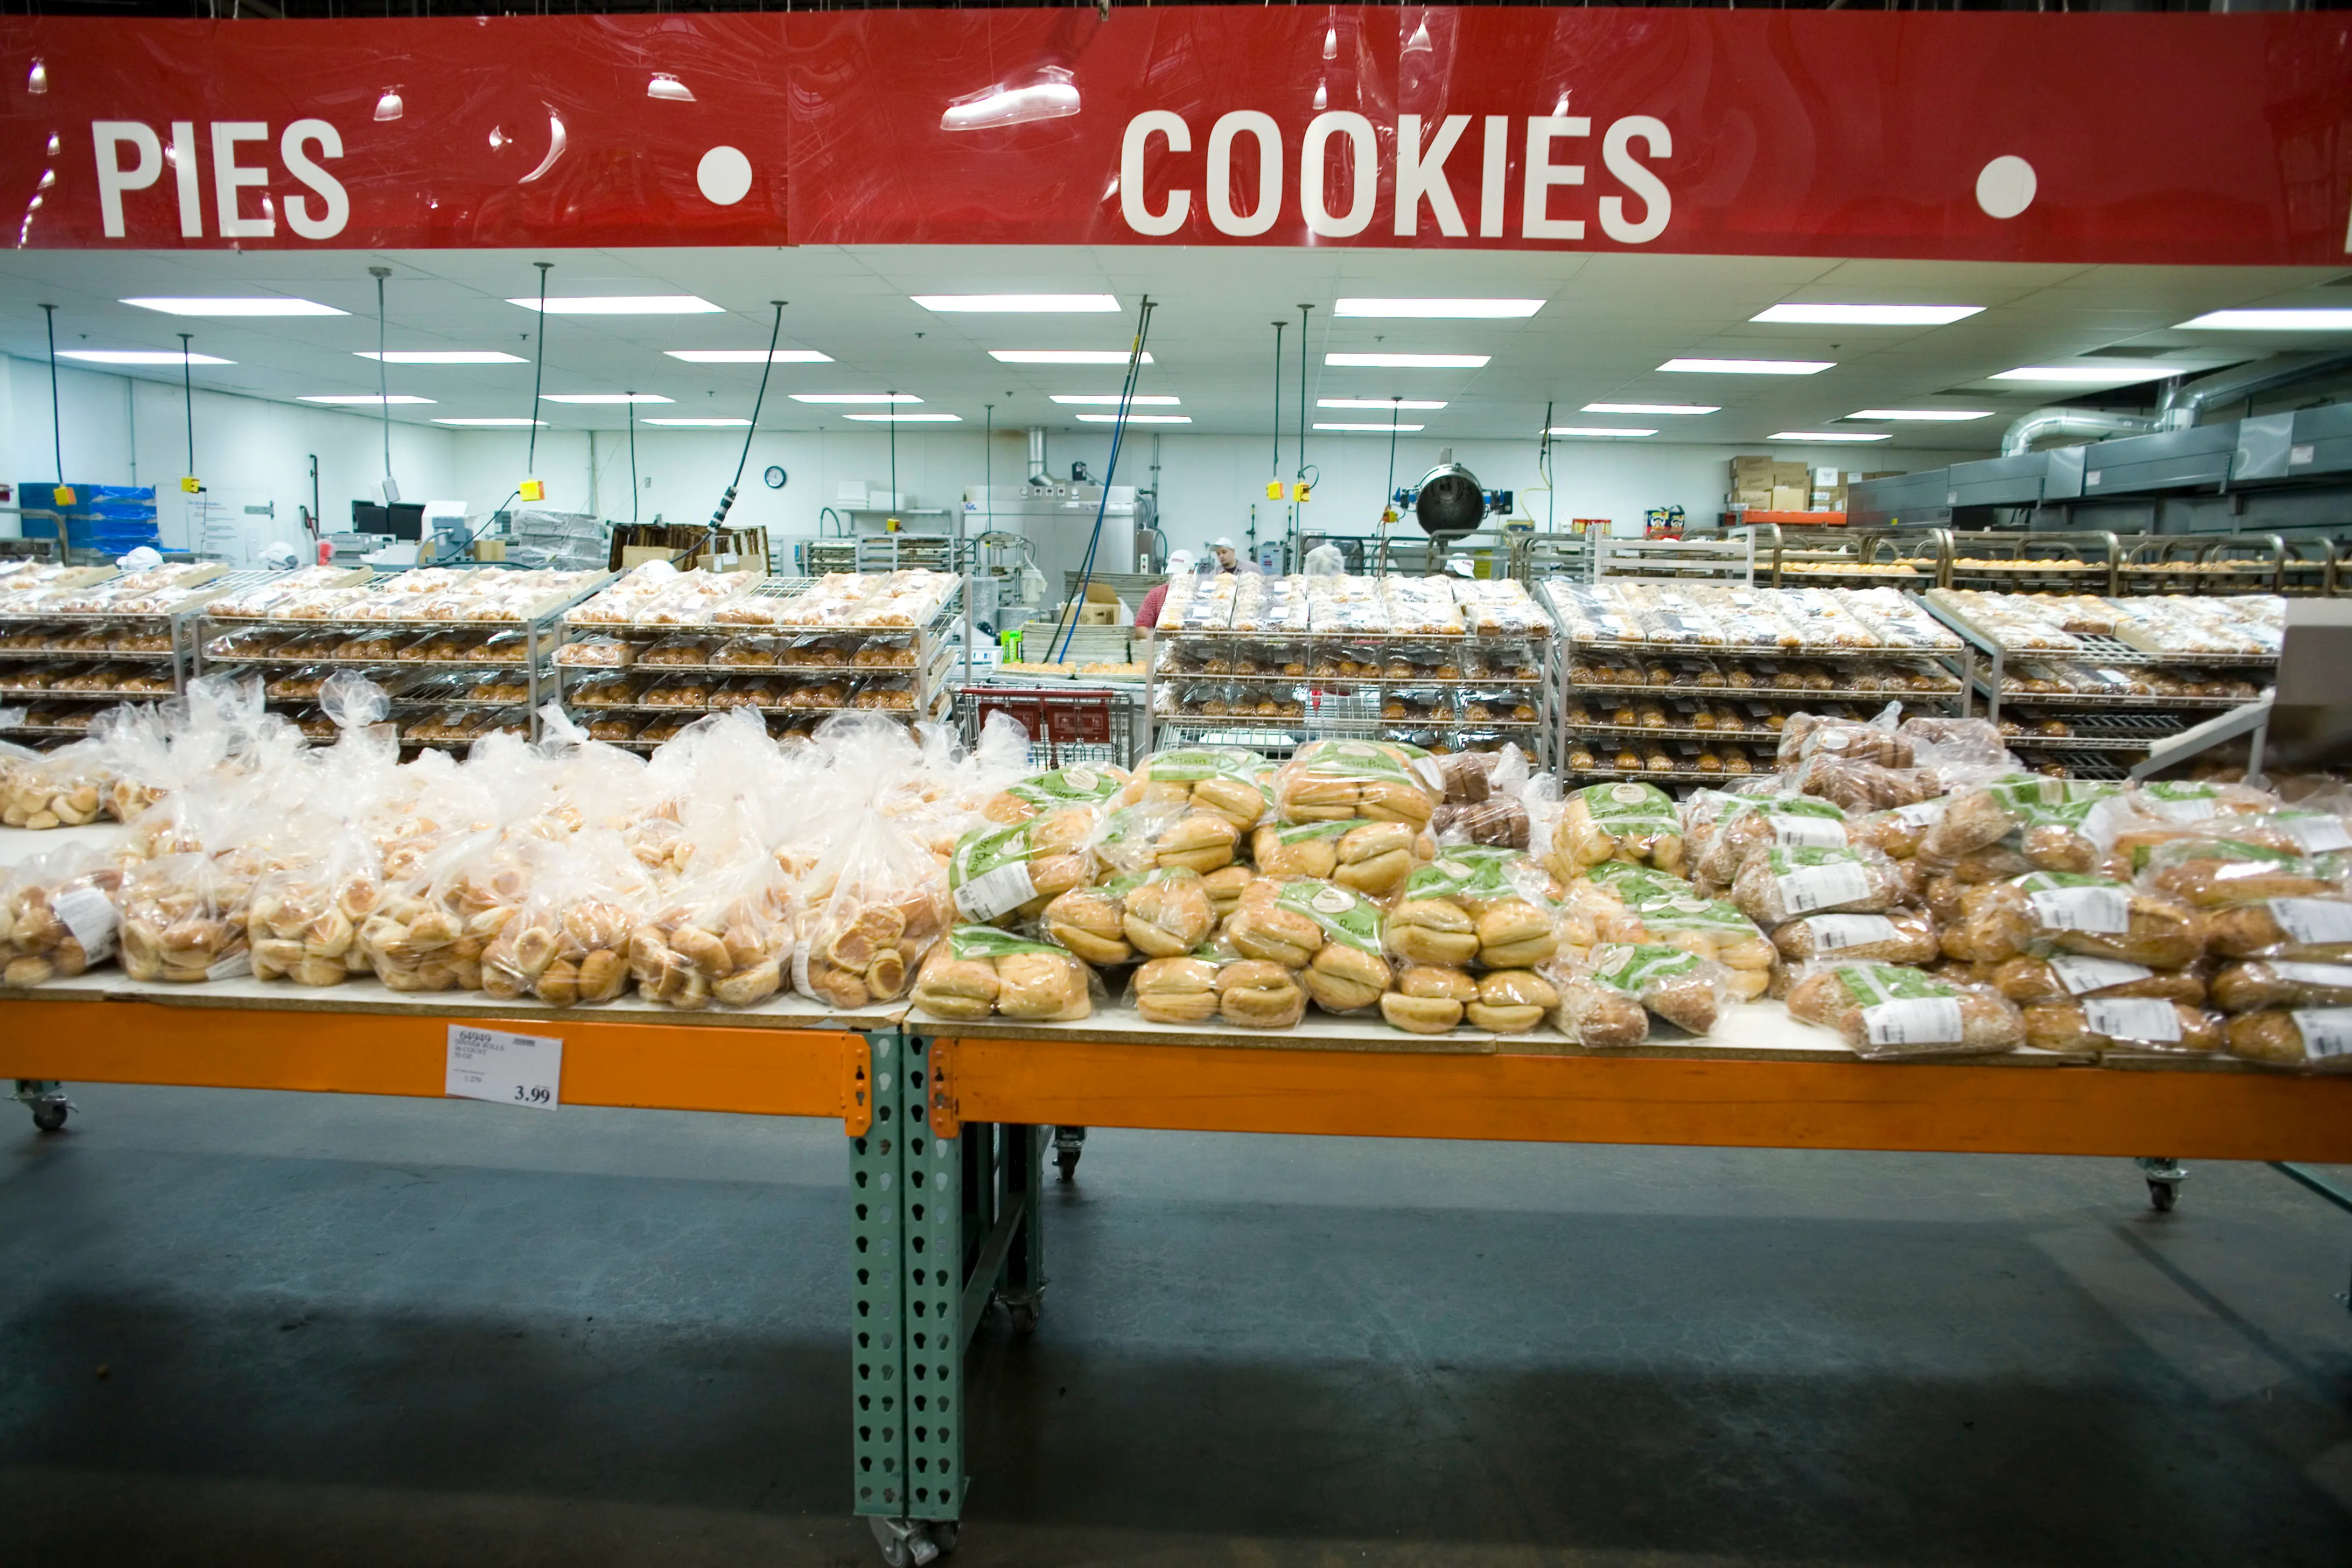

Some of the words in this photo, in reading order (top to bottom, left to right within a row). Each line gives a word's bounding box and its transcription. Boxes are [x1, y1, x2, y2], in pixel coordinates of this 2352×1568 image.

[92, 118, 349, 240] PIES
[1120, 109, 1673, 244] COOKIES
[459, 1030, 492, 1043] 64949
[463, 1046, 487, 1055] COUNT
[482, 1042, 505, 1052] ROLLS
[514, 1085, 550, 1104] 3.99
